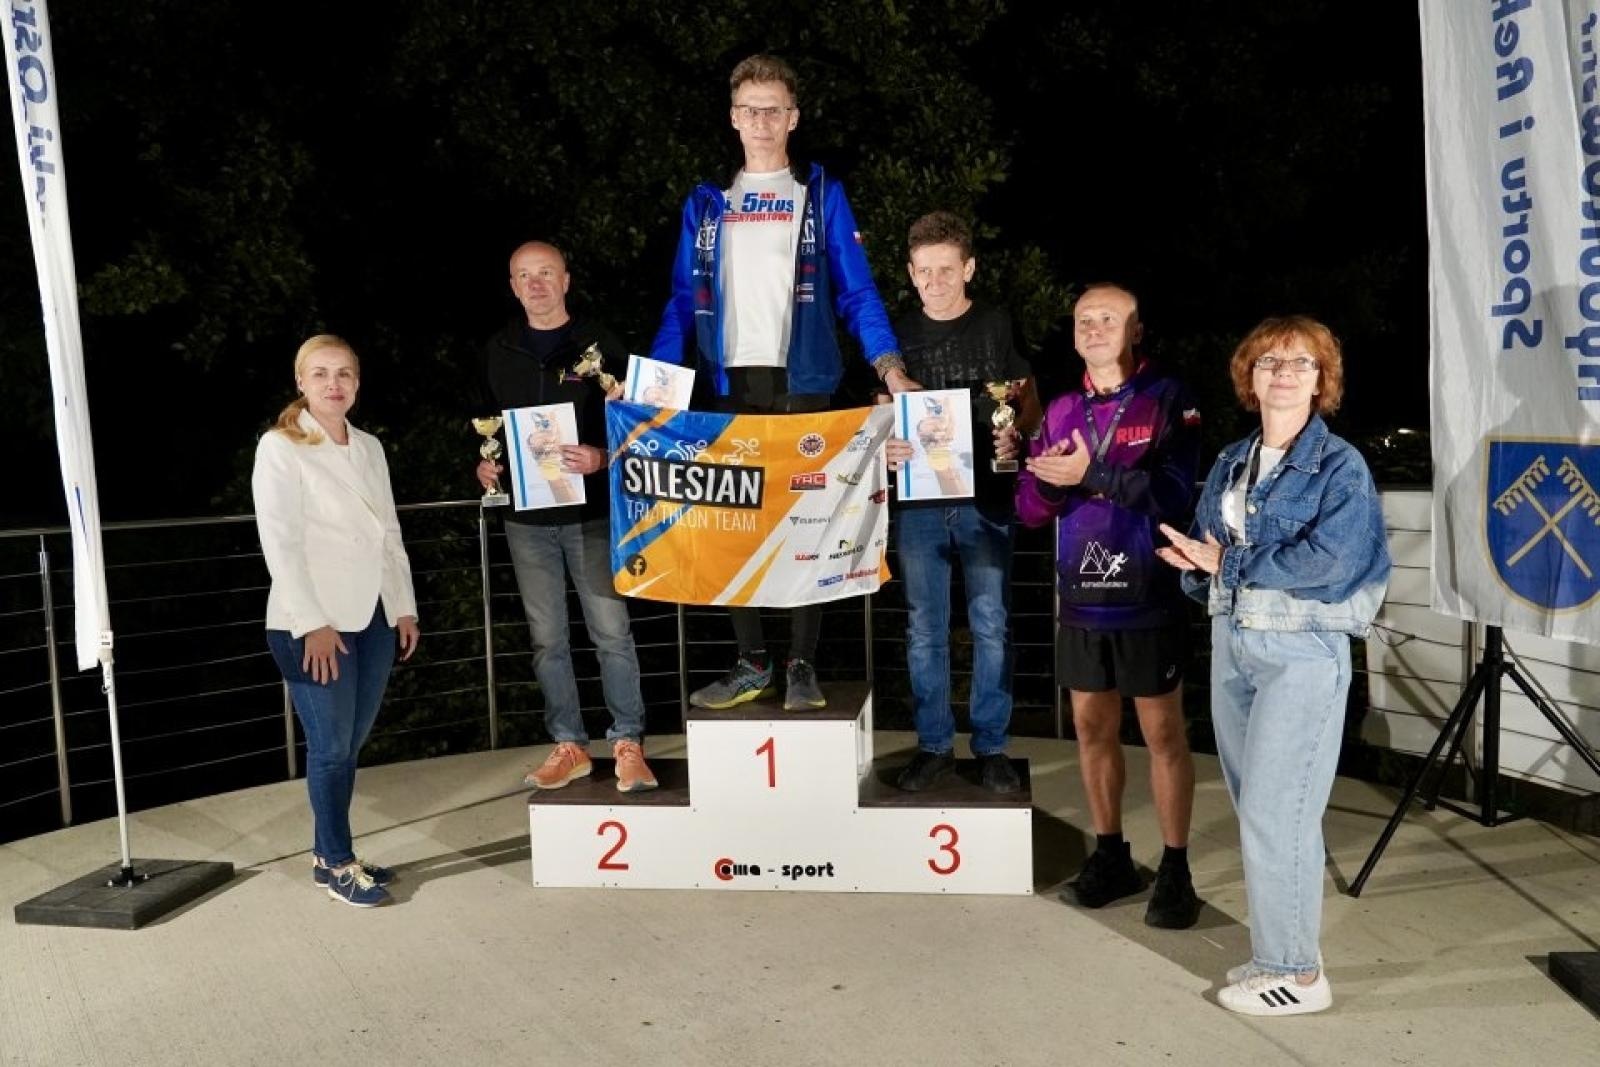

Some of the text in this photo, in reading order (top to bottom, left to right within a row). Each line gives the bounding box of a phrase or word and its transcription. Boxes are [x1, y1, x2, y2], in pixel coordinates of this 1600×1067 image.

[624, 457, 761, 504] SILESIAN
[624, 500, 756, 532] TRIATHLON TEAM
[755, 737, 776, 788] 1
[597, 821, 629, 870] 2
[928, 824, 961, 875] 3
[782, 862, 834, 880] sport
